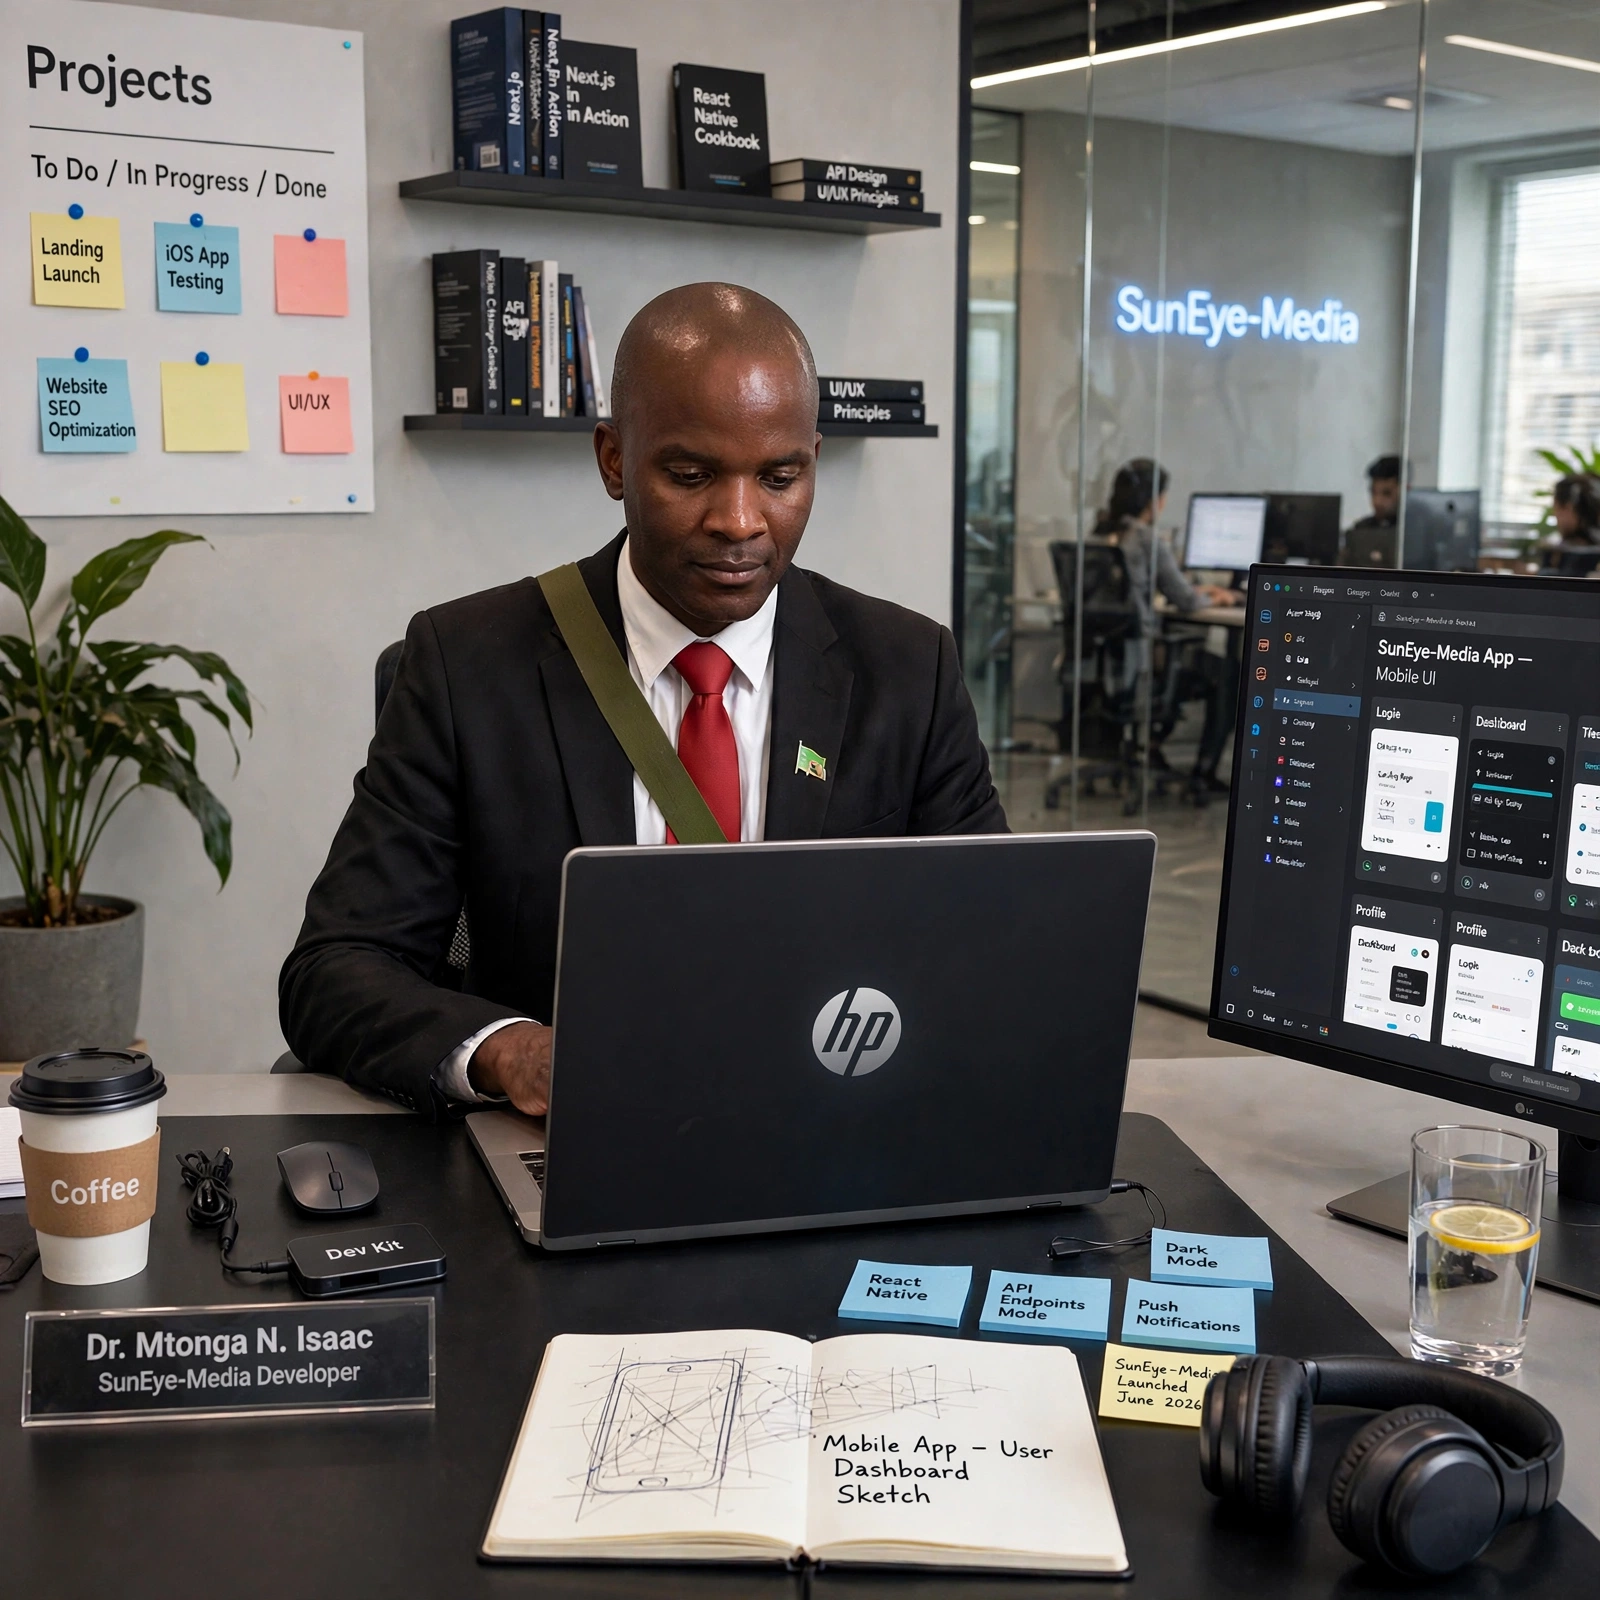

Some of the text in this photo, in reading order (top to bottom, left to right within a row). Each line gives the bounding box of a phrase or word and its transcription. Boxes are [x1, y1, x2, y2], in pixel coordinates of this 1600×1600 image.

[27, 44, 212, 108] Projects
[566, 65, 616, 91] Next.js
[566, 86, 580, 103] in
[693, 87, 731, 108] React
[567, 106, 630, 129] in Action
[694, 108, 738, 129] Native
[694, 128, 760, 151] Cookbook
[31, 154, 58, 179] To
[66, 157, 99, 181] Do
[127, 162, 147, 186] In
[155, 164, 249, 195] Progress
[275, 173, 327, 198] Done
[826, 164, 888, 188] API Design
[850, 187, 899, 208] Principles
[41, 237, 104, 262] Landing
[165, 244, 230, 268] iOS App
[43, 264, 100, 284] Launch
[167, 271, 224, 295] Testing
[1116, 285, 1359, 348] SunEye-Media
[46, 377, 108, 395] Website
[829, 381, 866, 399] UI/UX
[48, 400, 81, 416] SEO
[288, 393, 331, 412] UI/UX
[833, 403, 892, 423] Principles
[49, 421, 136, 441] Optimization
[1377, 639, 1480, 663] SunEye-Media
[1483, 647, 1514, 669] App
[1376, 666, 1437, 686] Mobile UI
[816, 986, 899, 1077] hp
[50, 1175, 140, 1206] Coffee
[325, 1239, 404, 1261] Dev Kit
[1166, 1242, 1208, 1256] Dark
[1167, 1255, 1218, 1269] Mode
[869, 1274, 922, 1288] React
[1002, 1282, 1033, 1295] API
[866, 1287, 928, 1302] Native
[1000, 1295, 1086, 1311] Endpoints
[998, 1307, 1048, 1321] Mode
[1138, 1299, 1179, 1313] Push
[1136, 1314, 1241, 1333] Notifications
[87, 1325, 374, 1363] Dr. Mtonga N. Isaac
[98, 1362, 361, 1396] SunEye-Media Developer
[1117, 1375, 1188, 1393] Launched
[1117, 1391, 1202, 1411] June 2026
[823, 1435, 901, 1454] Mobile
[914, 1437, 957, 1461] App
[1000, 1439, 1054, 1460] User
[834, 1458, 969, 1481] Dashboard
[838, 1484, 931, 1505] Sketch
